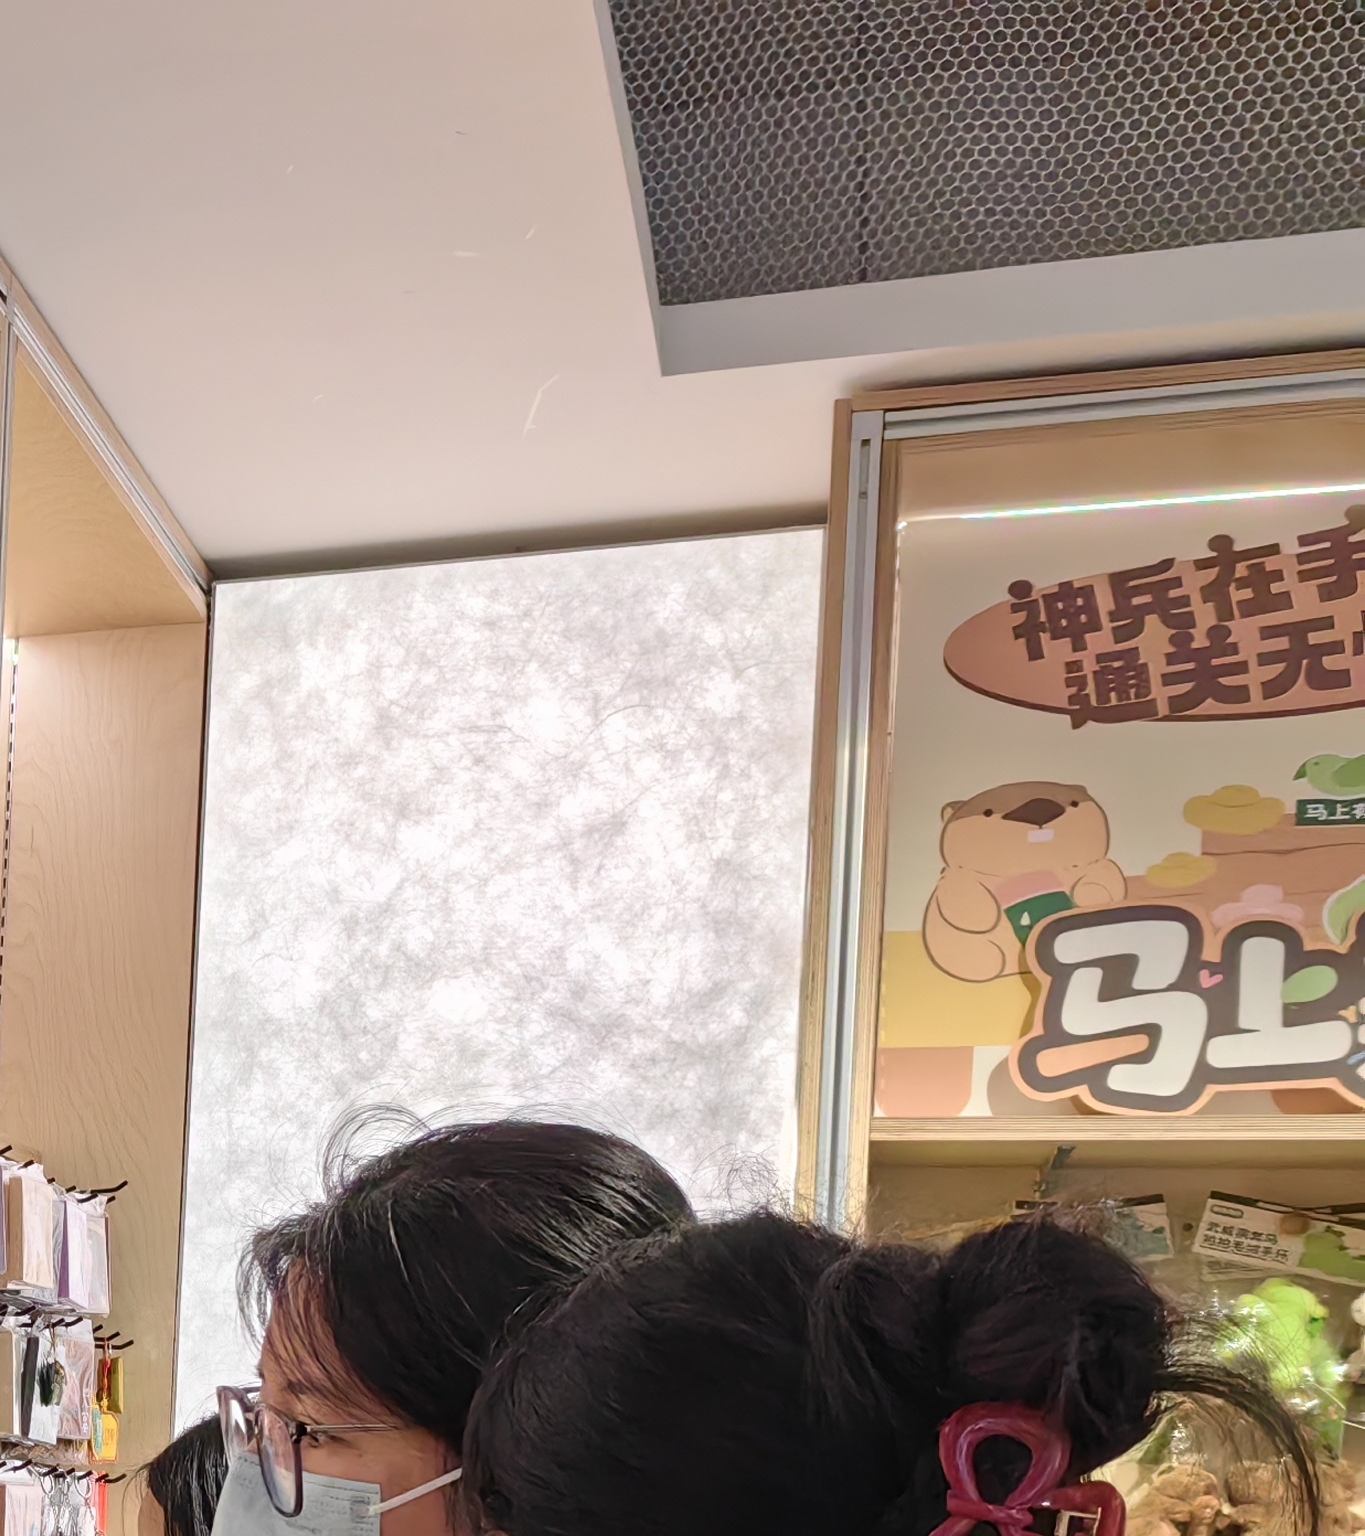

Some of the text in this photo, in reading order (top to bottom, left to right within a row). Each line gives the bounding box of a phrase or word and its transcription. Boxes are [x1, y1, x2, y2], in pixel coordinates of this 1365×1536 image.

[1007, 503, 1365, 662] 神兵在手
[1064, 617, 1365, 730] 通关无
